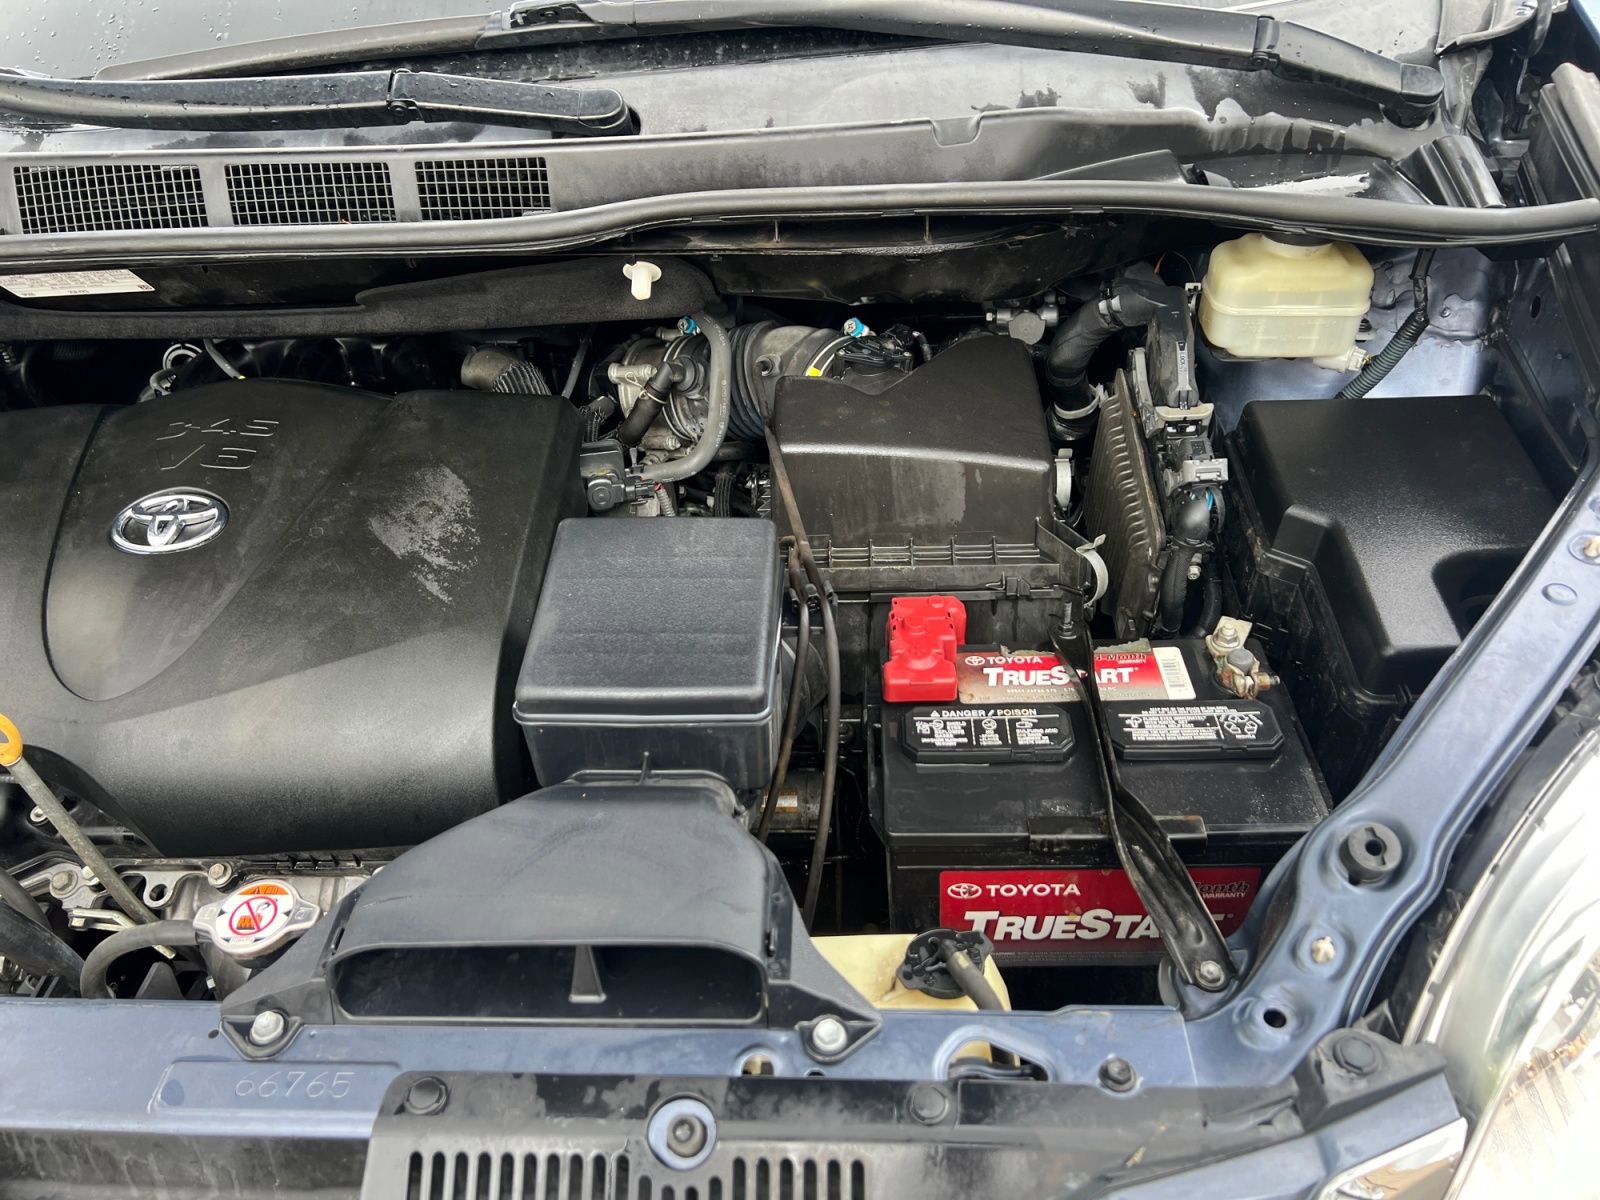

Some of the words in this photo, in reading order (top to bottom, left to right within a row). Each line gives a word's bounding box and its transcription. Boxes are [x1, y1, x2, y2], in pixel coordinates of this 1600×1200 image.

[986, 655, 1043, 665] TOYOTA
[941, 709, 986, 718] DANGER
[996, 707, 1038, 717] POISON
[985, 883, 1081, 897] TOYOTA
[235, 1071, 356, 1099] 66765
